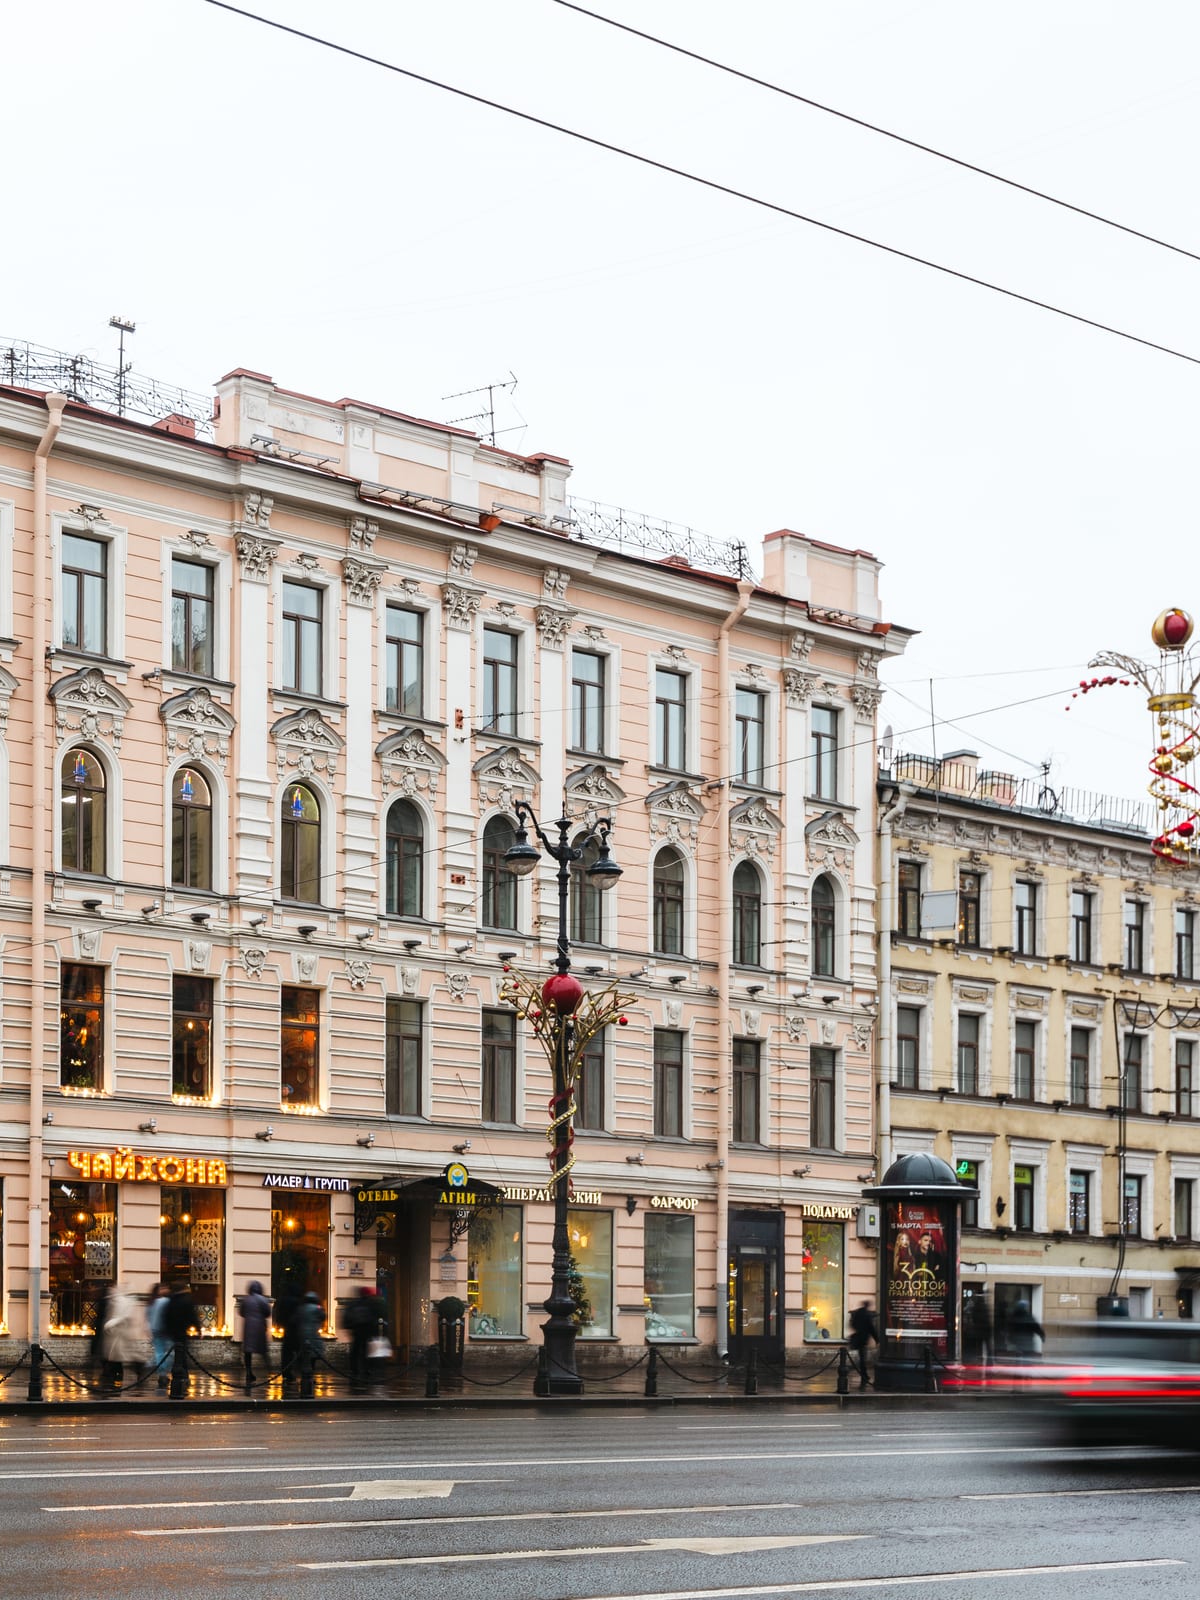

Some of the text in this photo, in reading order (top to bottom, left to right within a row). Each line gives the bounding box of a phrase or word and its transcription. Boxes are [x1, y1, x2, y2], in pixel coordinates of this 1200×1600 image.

[67, 1146, 227, 1185] ЧАЙХОНА
[264, 1173, 349, 1191] ЛИДЕР ГРУПП
[357, 1189, 399, 1202] ОТЕЛЬ
[439, 1191, 476, 1205] АГНИ
[650, 1195, 699, 1210] ФАРФОР
[802, 1204, 853, 1219] ПОДАРКИ
[889, 1279, 946, 1290] ЗОЛОТОЙ
